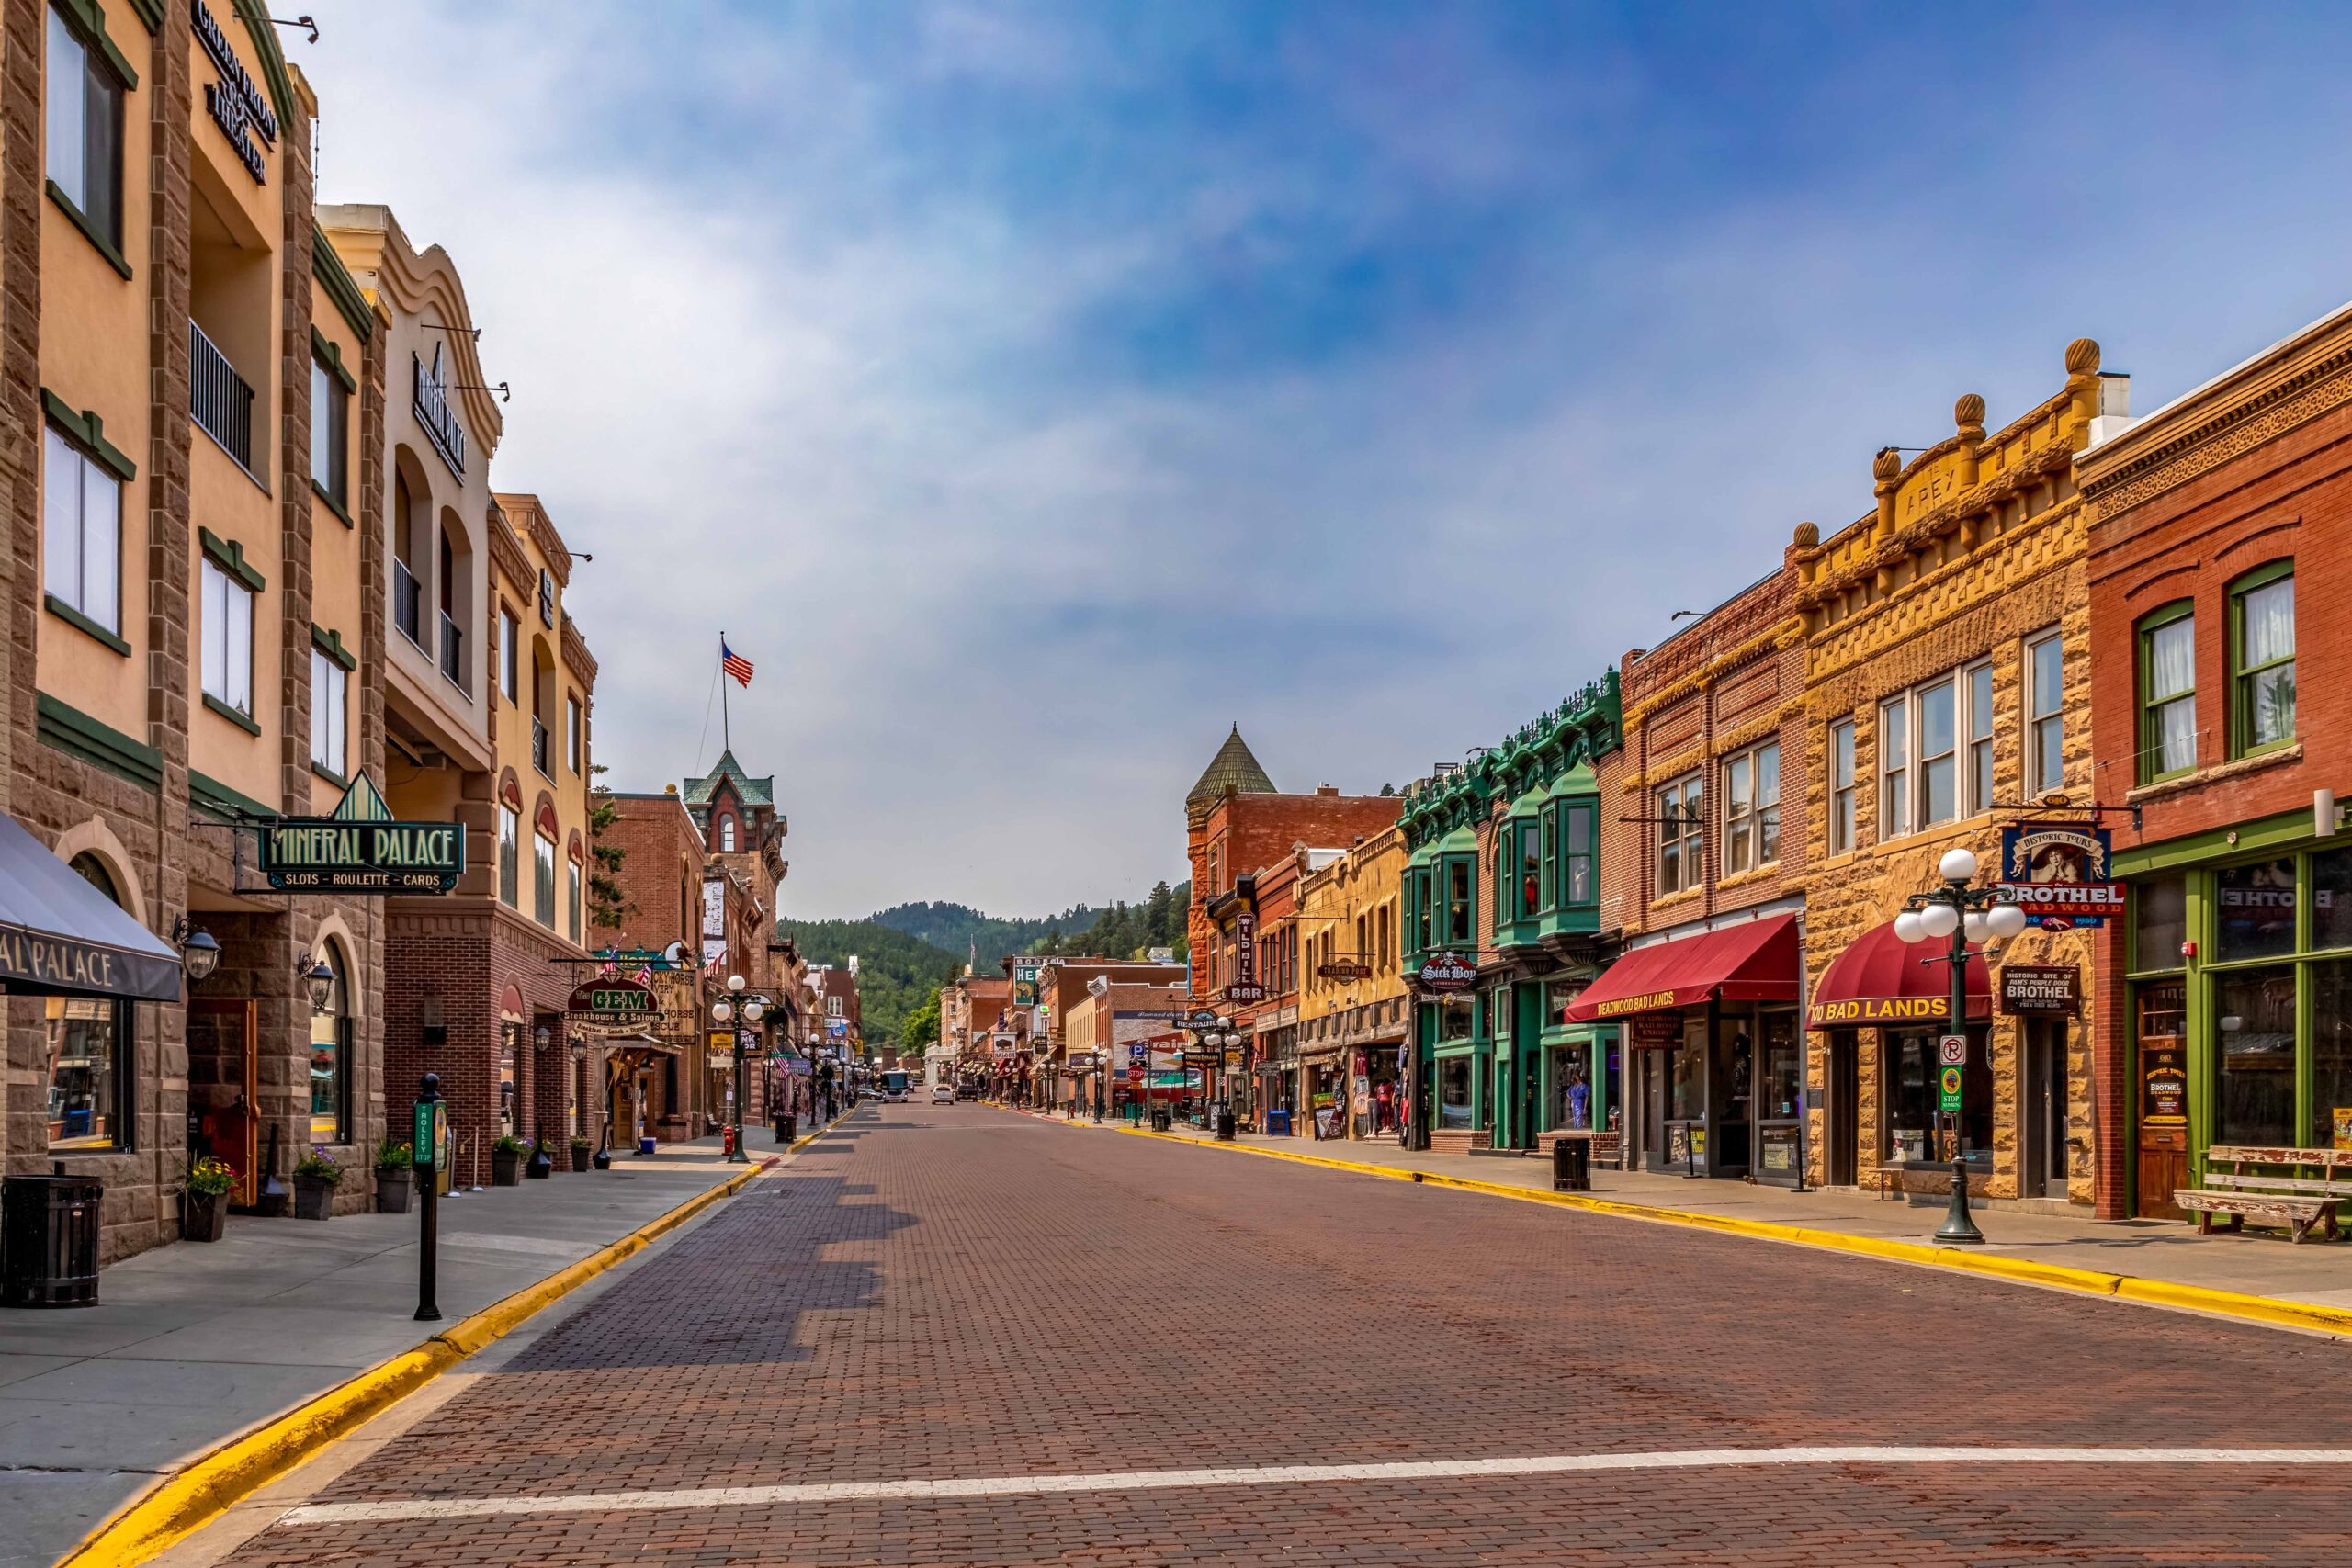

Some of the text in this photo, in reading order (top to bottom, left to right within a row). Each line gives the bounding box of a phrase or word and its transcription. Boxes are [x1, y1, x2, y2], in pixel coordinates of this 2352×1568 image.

[197, 0, 279, 138] GREEN FRONT
[212, 86, 266, 182] THEATER
[270, 829, 454, 865] MINERAL PALACE
[2023, 833, 2093, 848] HISTORIC TOURS
[285, 874, 440, 886] SLOTS ROULETTE CARDS
[1995, 883, 2125, 904] BROTHEL
[2027, 903, 2122, 913] ADWOOD
[1241, 918, 1250, 948] WILD
[32, 941, 113, 987] PALACE
[1241, 953, 1250, 983] BILL
[1420, 964, 1476, 981] Sick Boy
[670, 972, 695, 986] HORSE
[591, 989, 649, 1011] GEM
[1231, 987, 1262, 998] BAR
[2007, 986, 2073, 998] BROTHEL
[1597, 991, 1674, 1016] DEADWOOD BAD LANDS
[1826, 1001, 1860, 1021] BAD
[1865, 998, 1948, 1018] LANDS
[563, 1011, 661, 1021] Steakhouse & Saloon
[577, 1023, 602, 1033] Breakfast
[630, 1025, 648, 1033] Dinner
[1134, 1045, 1143, 1057] P
[2150, 1083, 2182, 1091] BROTHEL
